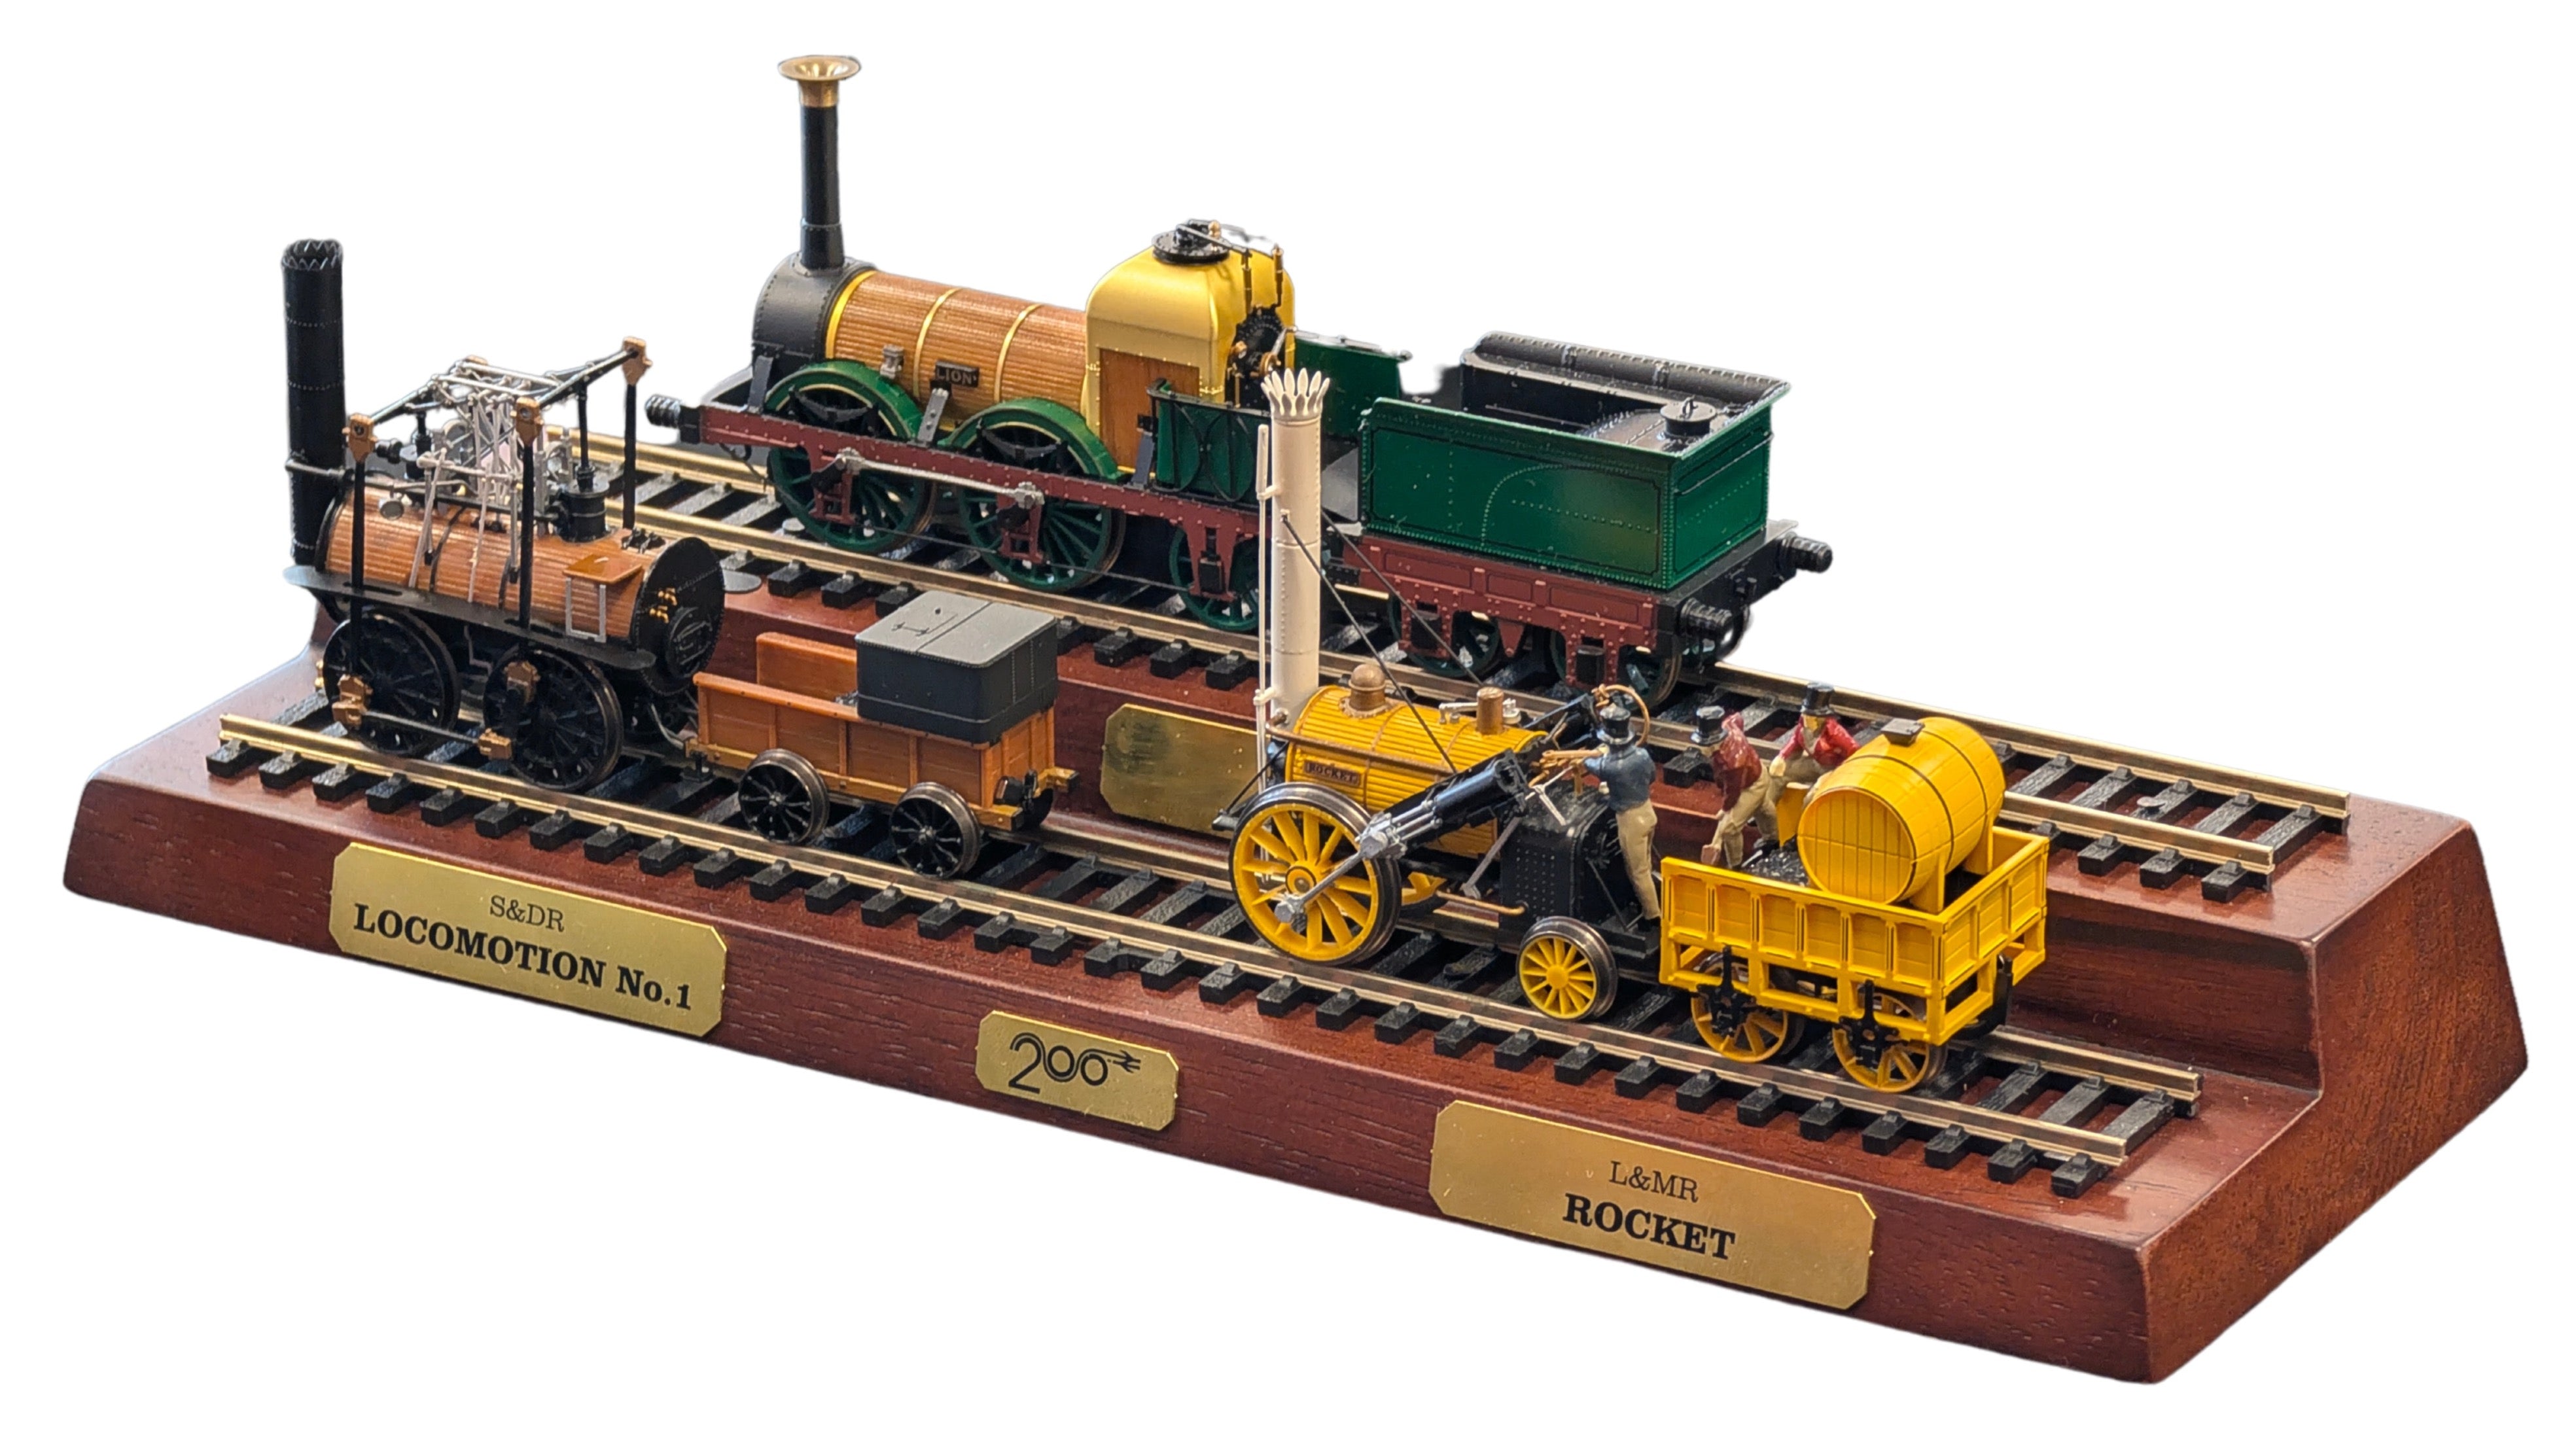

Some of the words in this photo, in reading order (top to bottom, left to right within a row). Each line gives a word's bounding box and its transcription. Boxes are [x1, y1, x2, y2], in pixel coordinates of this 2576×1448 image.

[490, 895, 564, 932] S&DR
[353, 903, 607, 988] LOCOMOTION
[615, 965, 691, 1010] No.1
[1008, 1032, 1108, 1095] 200
[1609, 1161, 1699, 1203] L&MR
[1562, 1193, 1736, 1260] ROCKET
